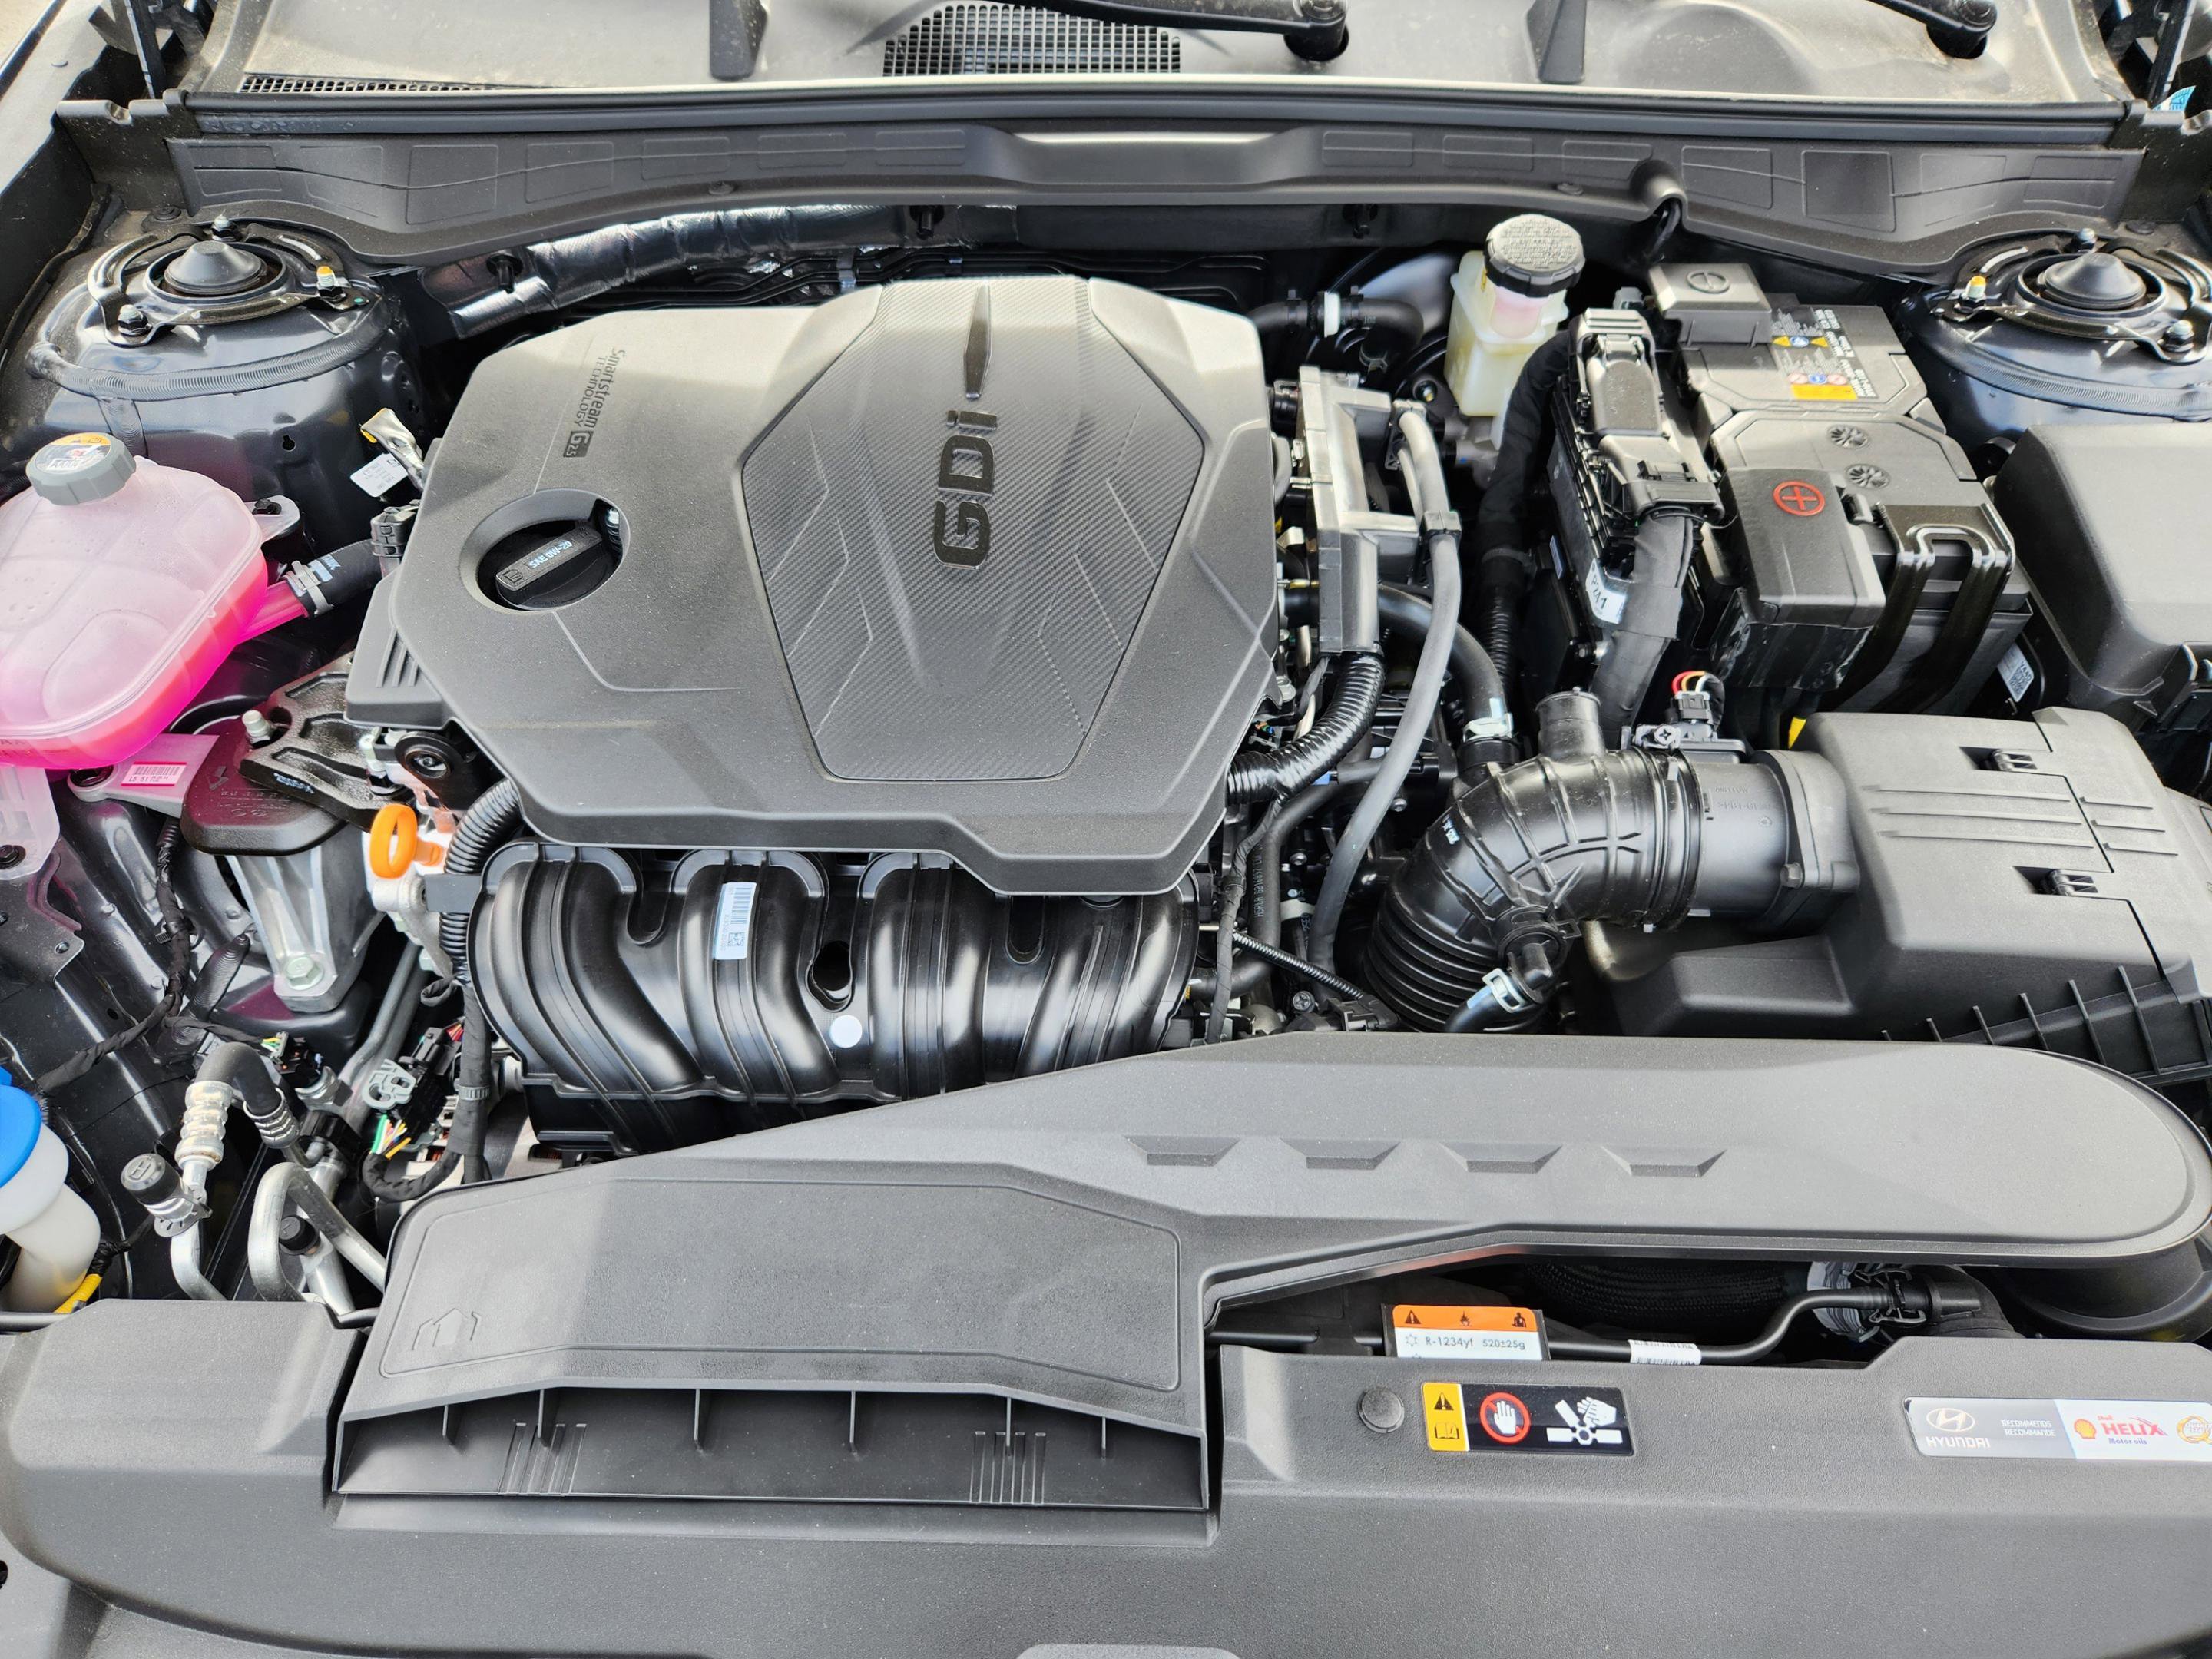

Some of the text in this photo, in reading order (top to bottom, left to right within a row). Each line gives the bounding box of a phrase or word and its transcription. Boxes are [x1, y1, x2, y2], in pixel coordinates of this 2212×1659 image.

[574, 356, 608, 427] TECHNOLOGY
[584, 347, 626, 429] Smartstream
[933, 409, 997, 570] GDi
[528, 540, 573, 569] SAE 0W-20
[1425, 1336, 1525, 1350] R-1234yf 520±25g
[2101, 1422, 2165, 1437] HELIX
[1925, 1435, 1992, 1449] HYUNDAI
[2133, 1437, 2148, 1445] oils
